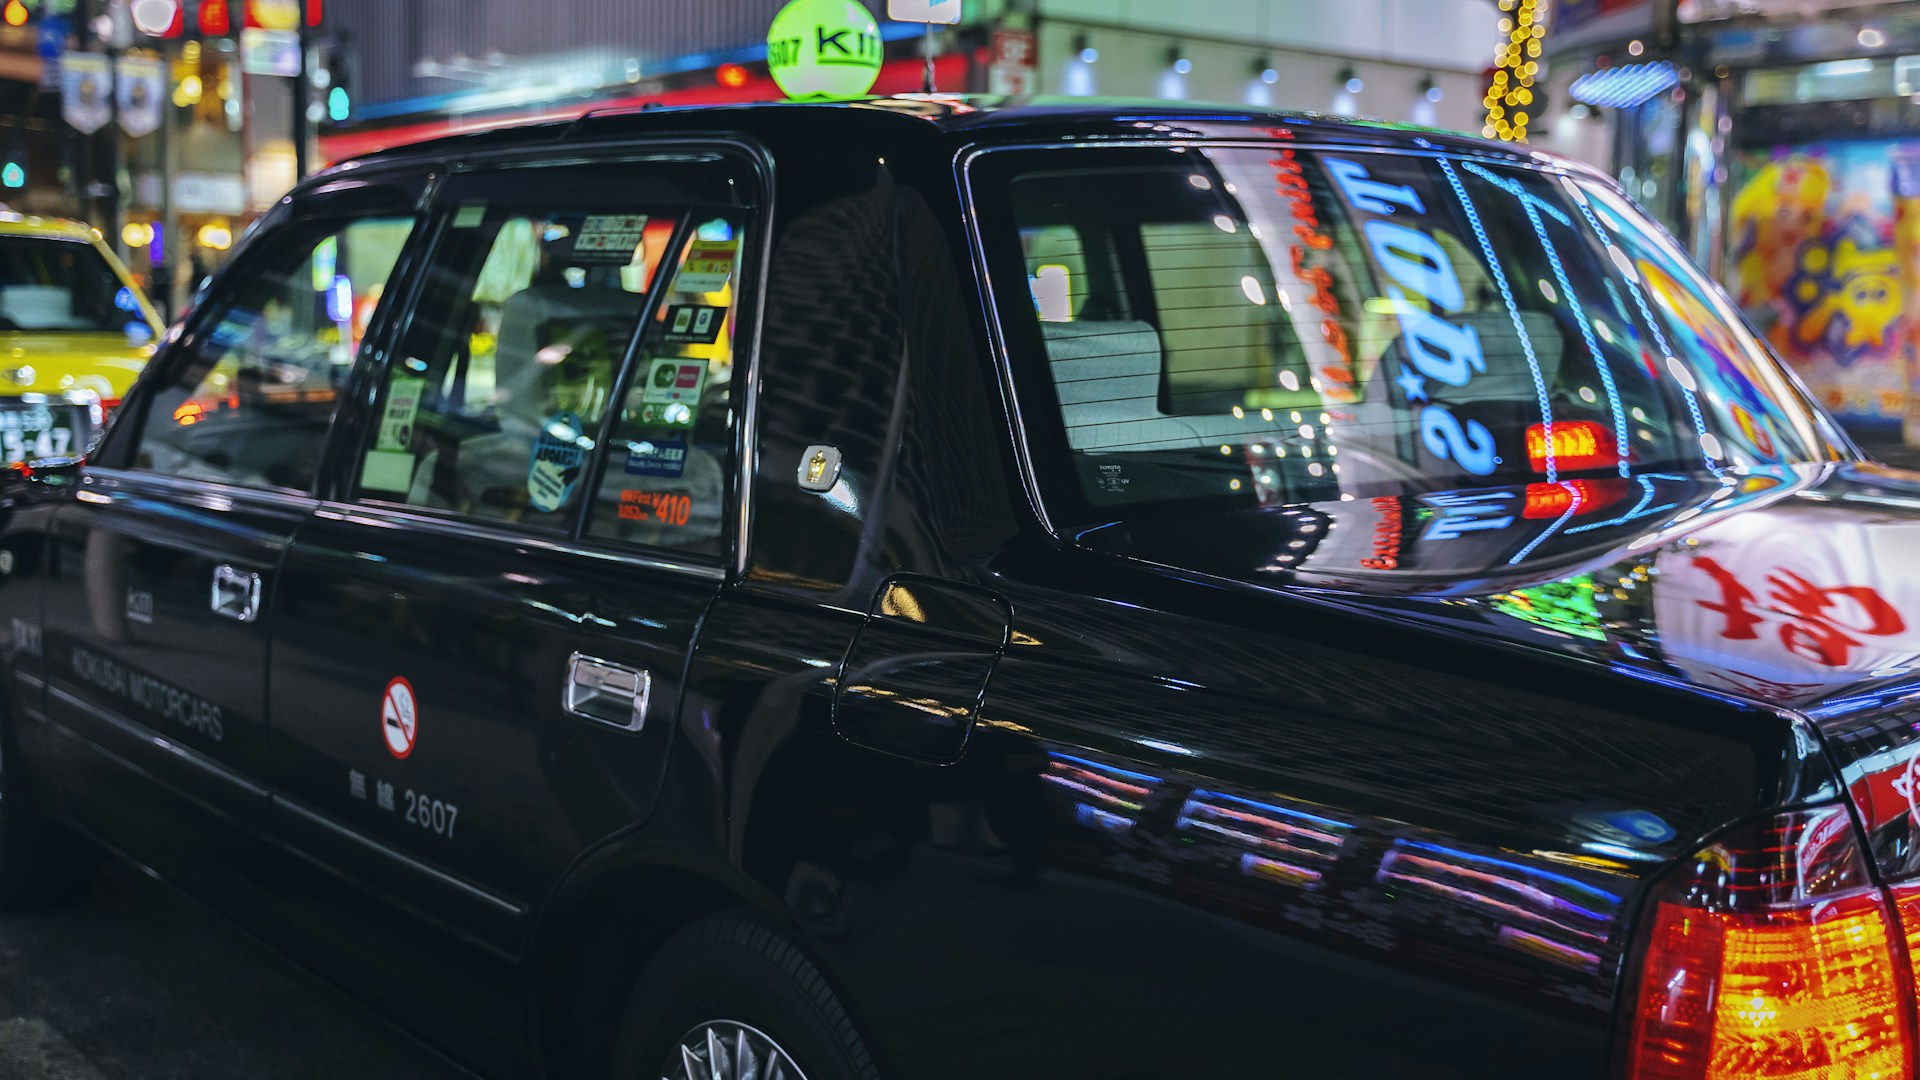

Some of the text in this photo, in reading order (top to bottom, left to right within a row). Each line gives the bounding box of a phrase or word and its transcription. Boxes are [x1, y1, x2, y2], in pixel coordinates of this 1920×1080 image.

[0, 427, 71, 462] 5-47
[129, 671, 224, 742] MOTORCARS
[405, 789, 458, 839] 2607
